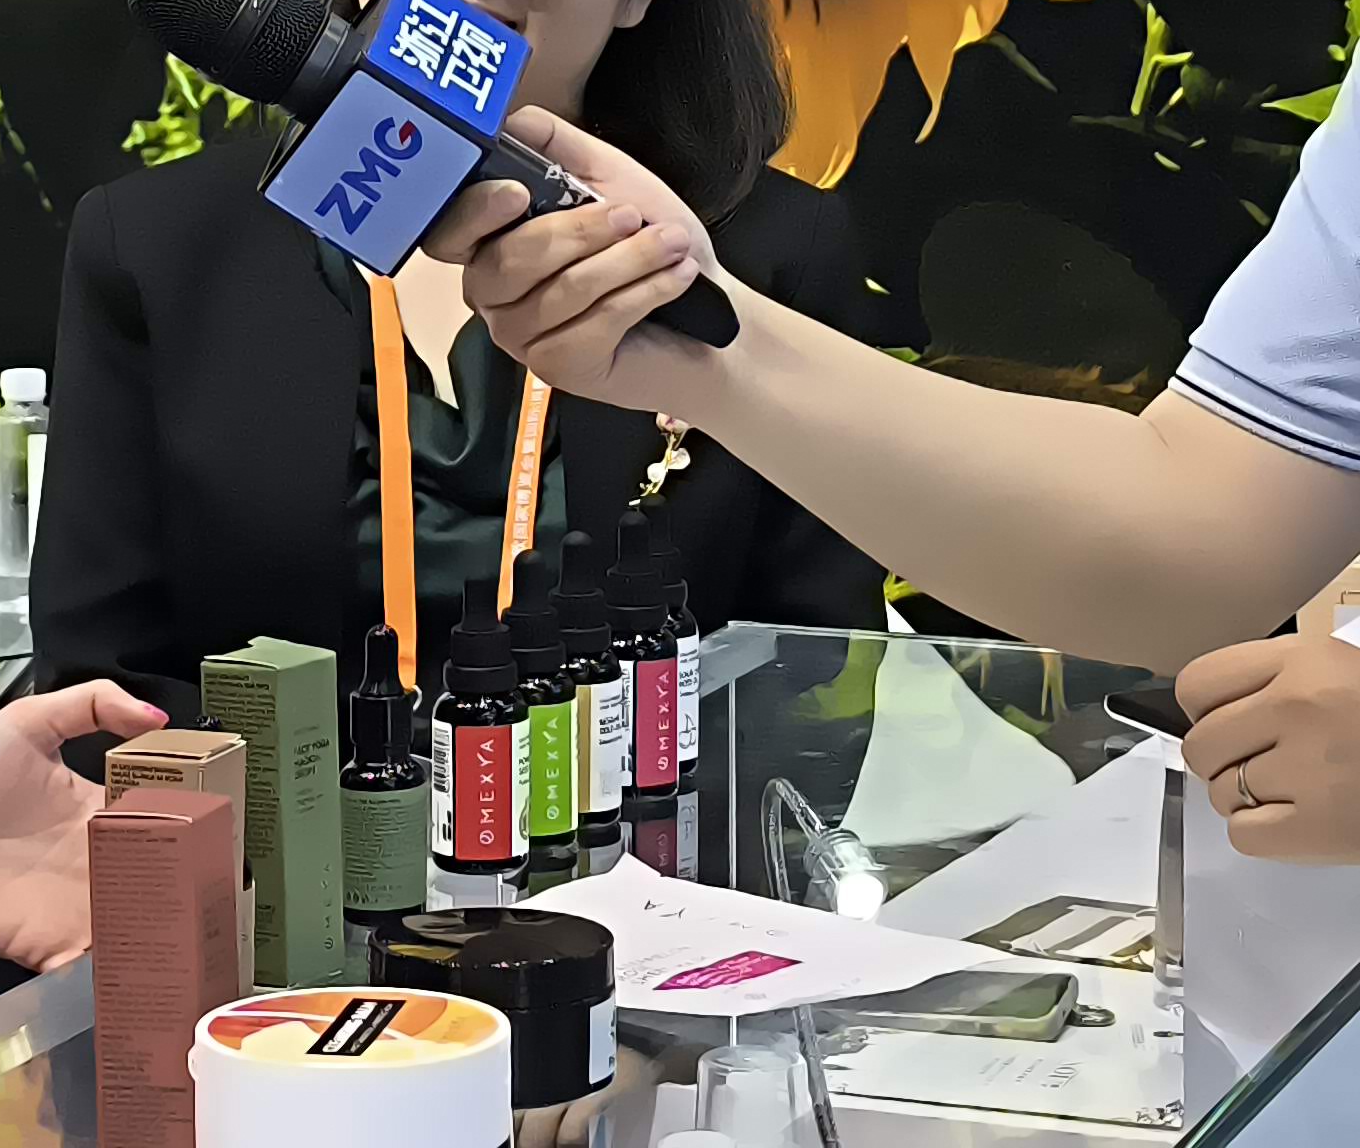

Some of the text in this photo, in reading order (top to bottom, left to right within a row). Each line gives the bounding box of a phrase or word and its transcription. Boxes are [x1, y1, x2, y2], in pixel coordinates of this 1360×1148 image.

[439, 19, 507, 113] 卫视
[313, 116, 423, 236] ZMG
[656, 669, 671, 751] MEXYA
[479, 738, 496, 823] MEXYA
[542, 716, 560, 799] MEXYA
